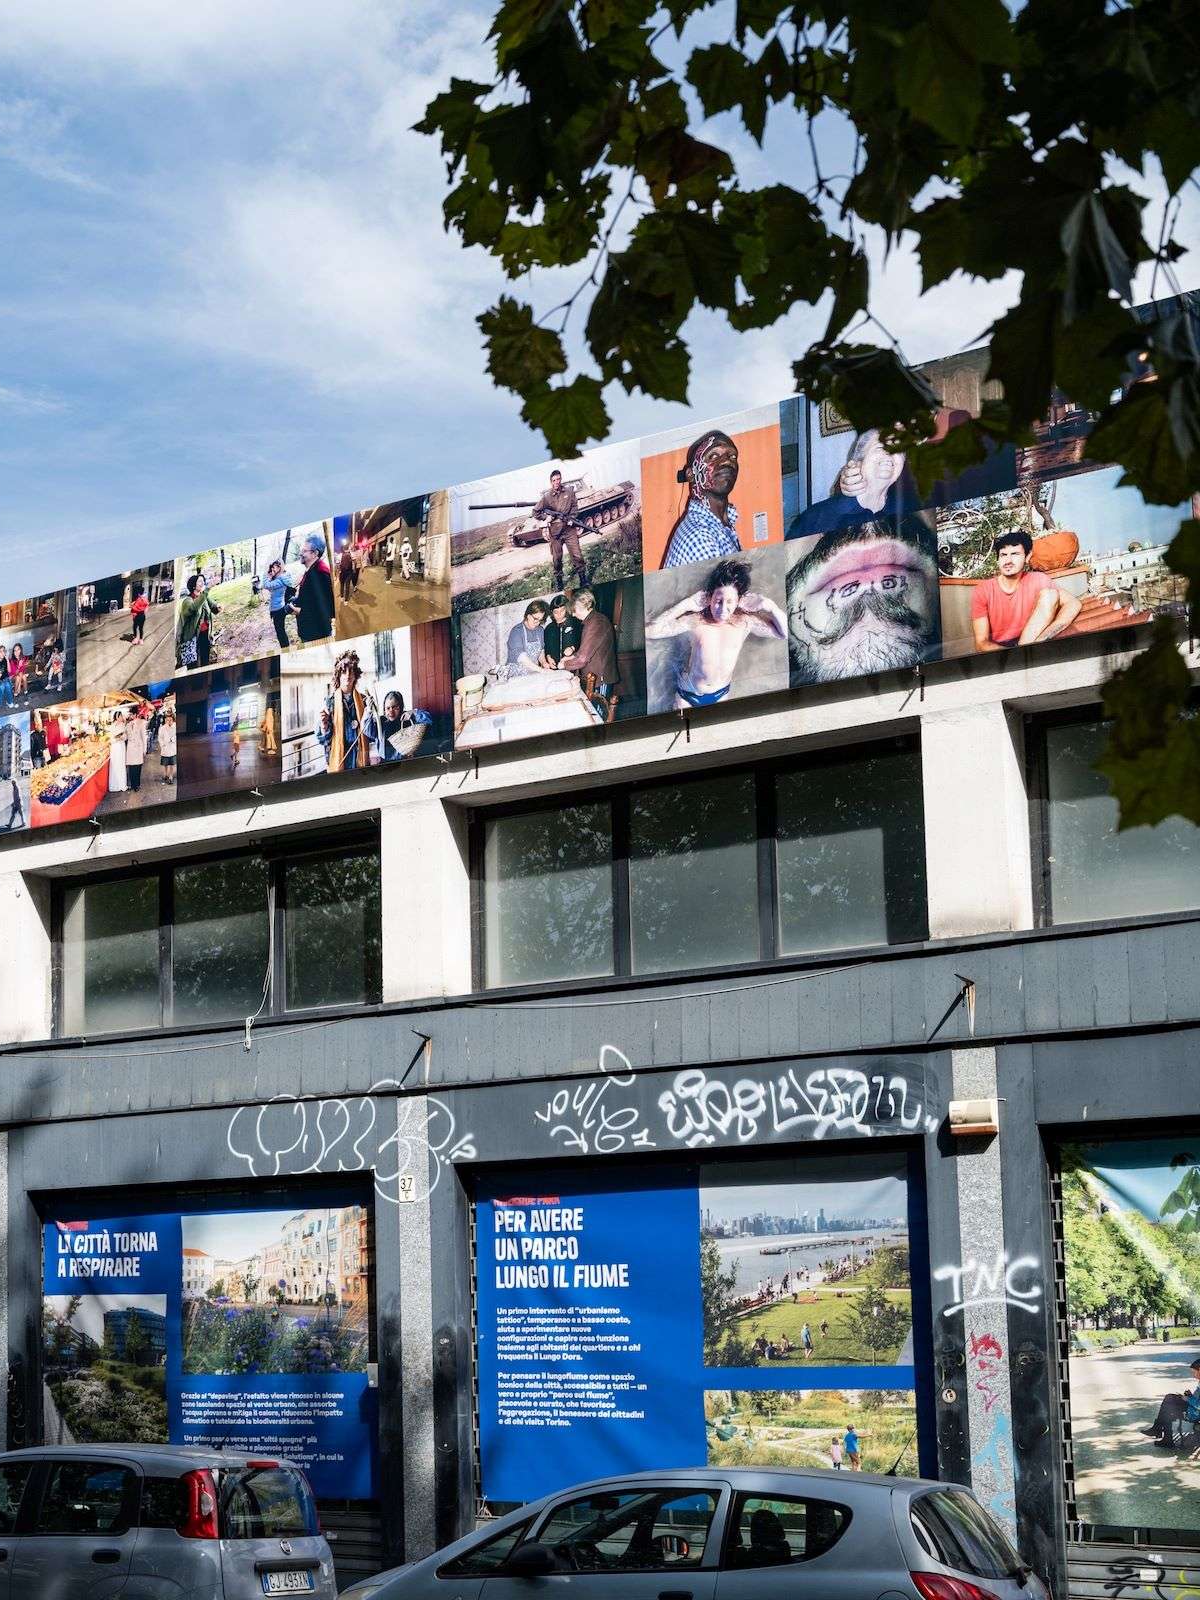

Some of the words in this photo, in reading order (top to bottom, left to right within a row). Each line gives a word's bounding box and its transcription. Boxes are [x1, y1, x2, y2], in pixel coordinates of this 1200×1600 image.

[400, 1177, 412, 1189] 37
[495, 1211, 526, 1232] PER
[530, 1208, 583, 1232] AVERE
[58, 1234, 72, 1254] LA
[74, 1229, 111, 1253] CITTÀ
[114, 1231, 158, 1252] TORNA
[495, 1238, 518, 1260] UN
[521, 1236, 578, 1260] PARCO
[58, 1258, 66, 1277] A
[69, 1257, 140, 1277] RESPIRARE
[496, 1265, 549, 1288] LUNGO
[553, 1265, 569, 1288] IL
[574, 1264, 629, 1288] FIUME
